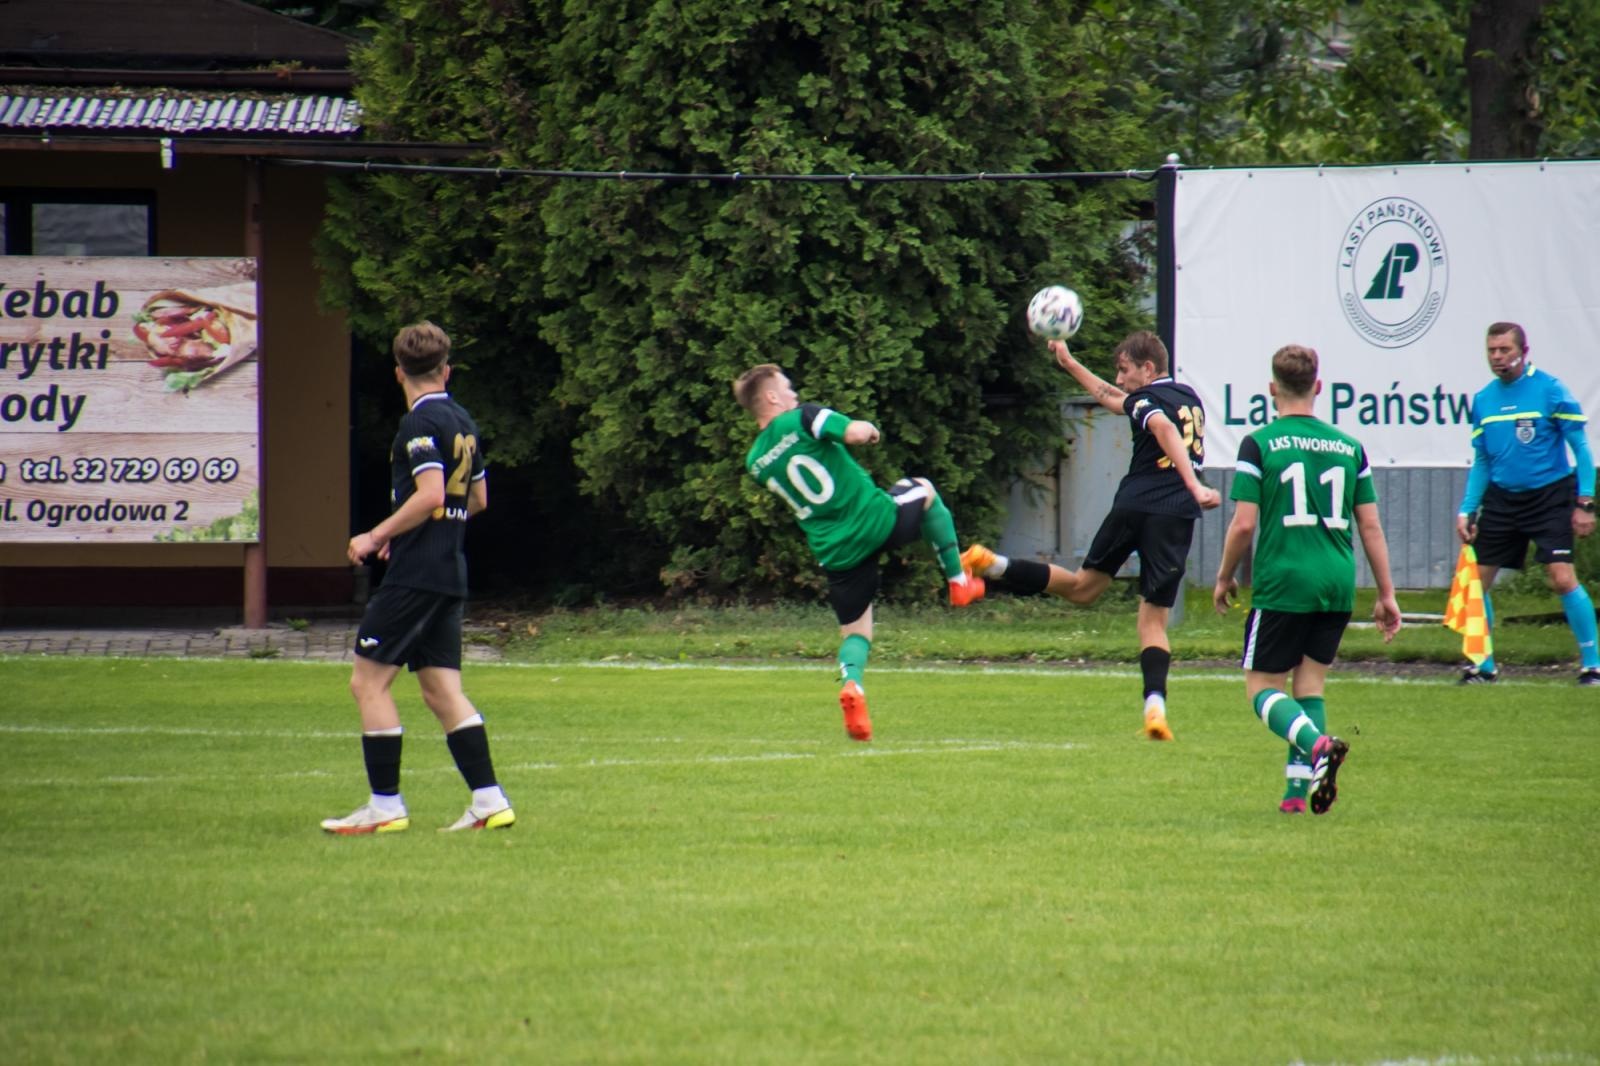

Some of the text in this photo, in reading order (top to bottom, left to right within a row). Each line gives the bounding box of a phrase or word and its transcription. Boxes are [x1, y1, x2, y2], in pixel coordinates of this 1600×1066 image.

[1342, 201, 1444, 267] LASY PAŃSTWOWE
[0, 281, 119, 318] ebab
[1, 384, 86, 432] ody
[1332, 381, 1473, 425] Państw
[1268, 436, 1356, 457] LKS TWORKÓW
[20, 456, 68, 483] tel.
[72, 457, 106, 483] 32
[111, 457, 160, 483] 729
[163, 457, 199, 483] 69
[203, 457, 239, 483] 69
[766, 454, 835, 521] 10
[0, 499, 189, 527] l. Ogrodowa 2
[1280, 462, 1349, 530] 11
